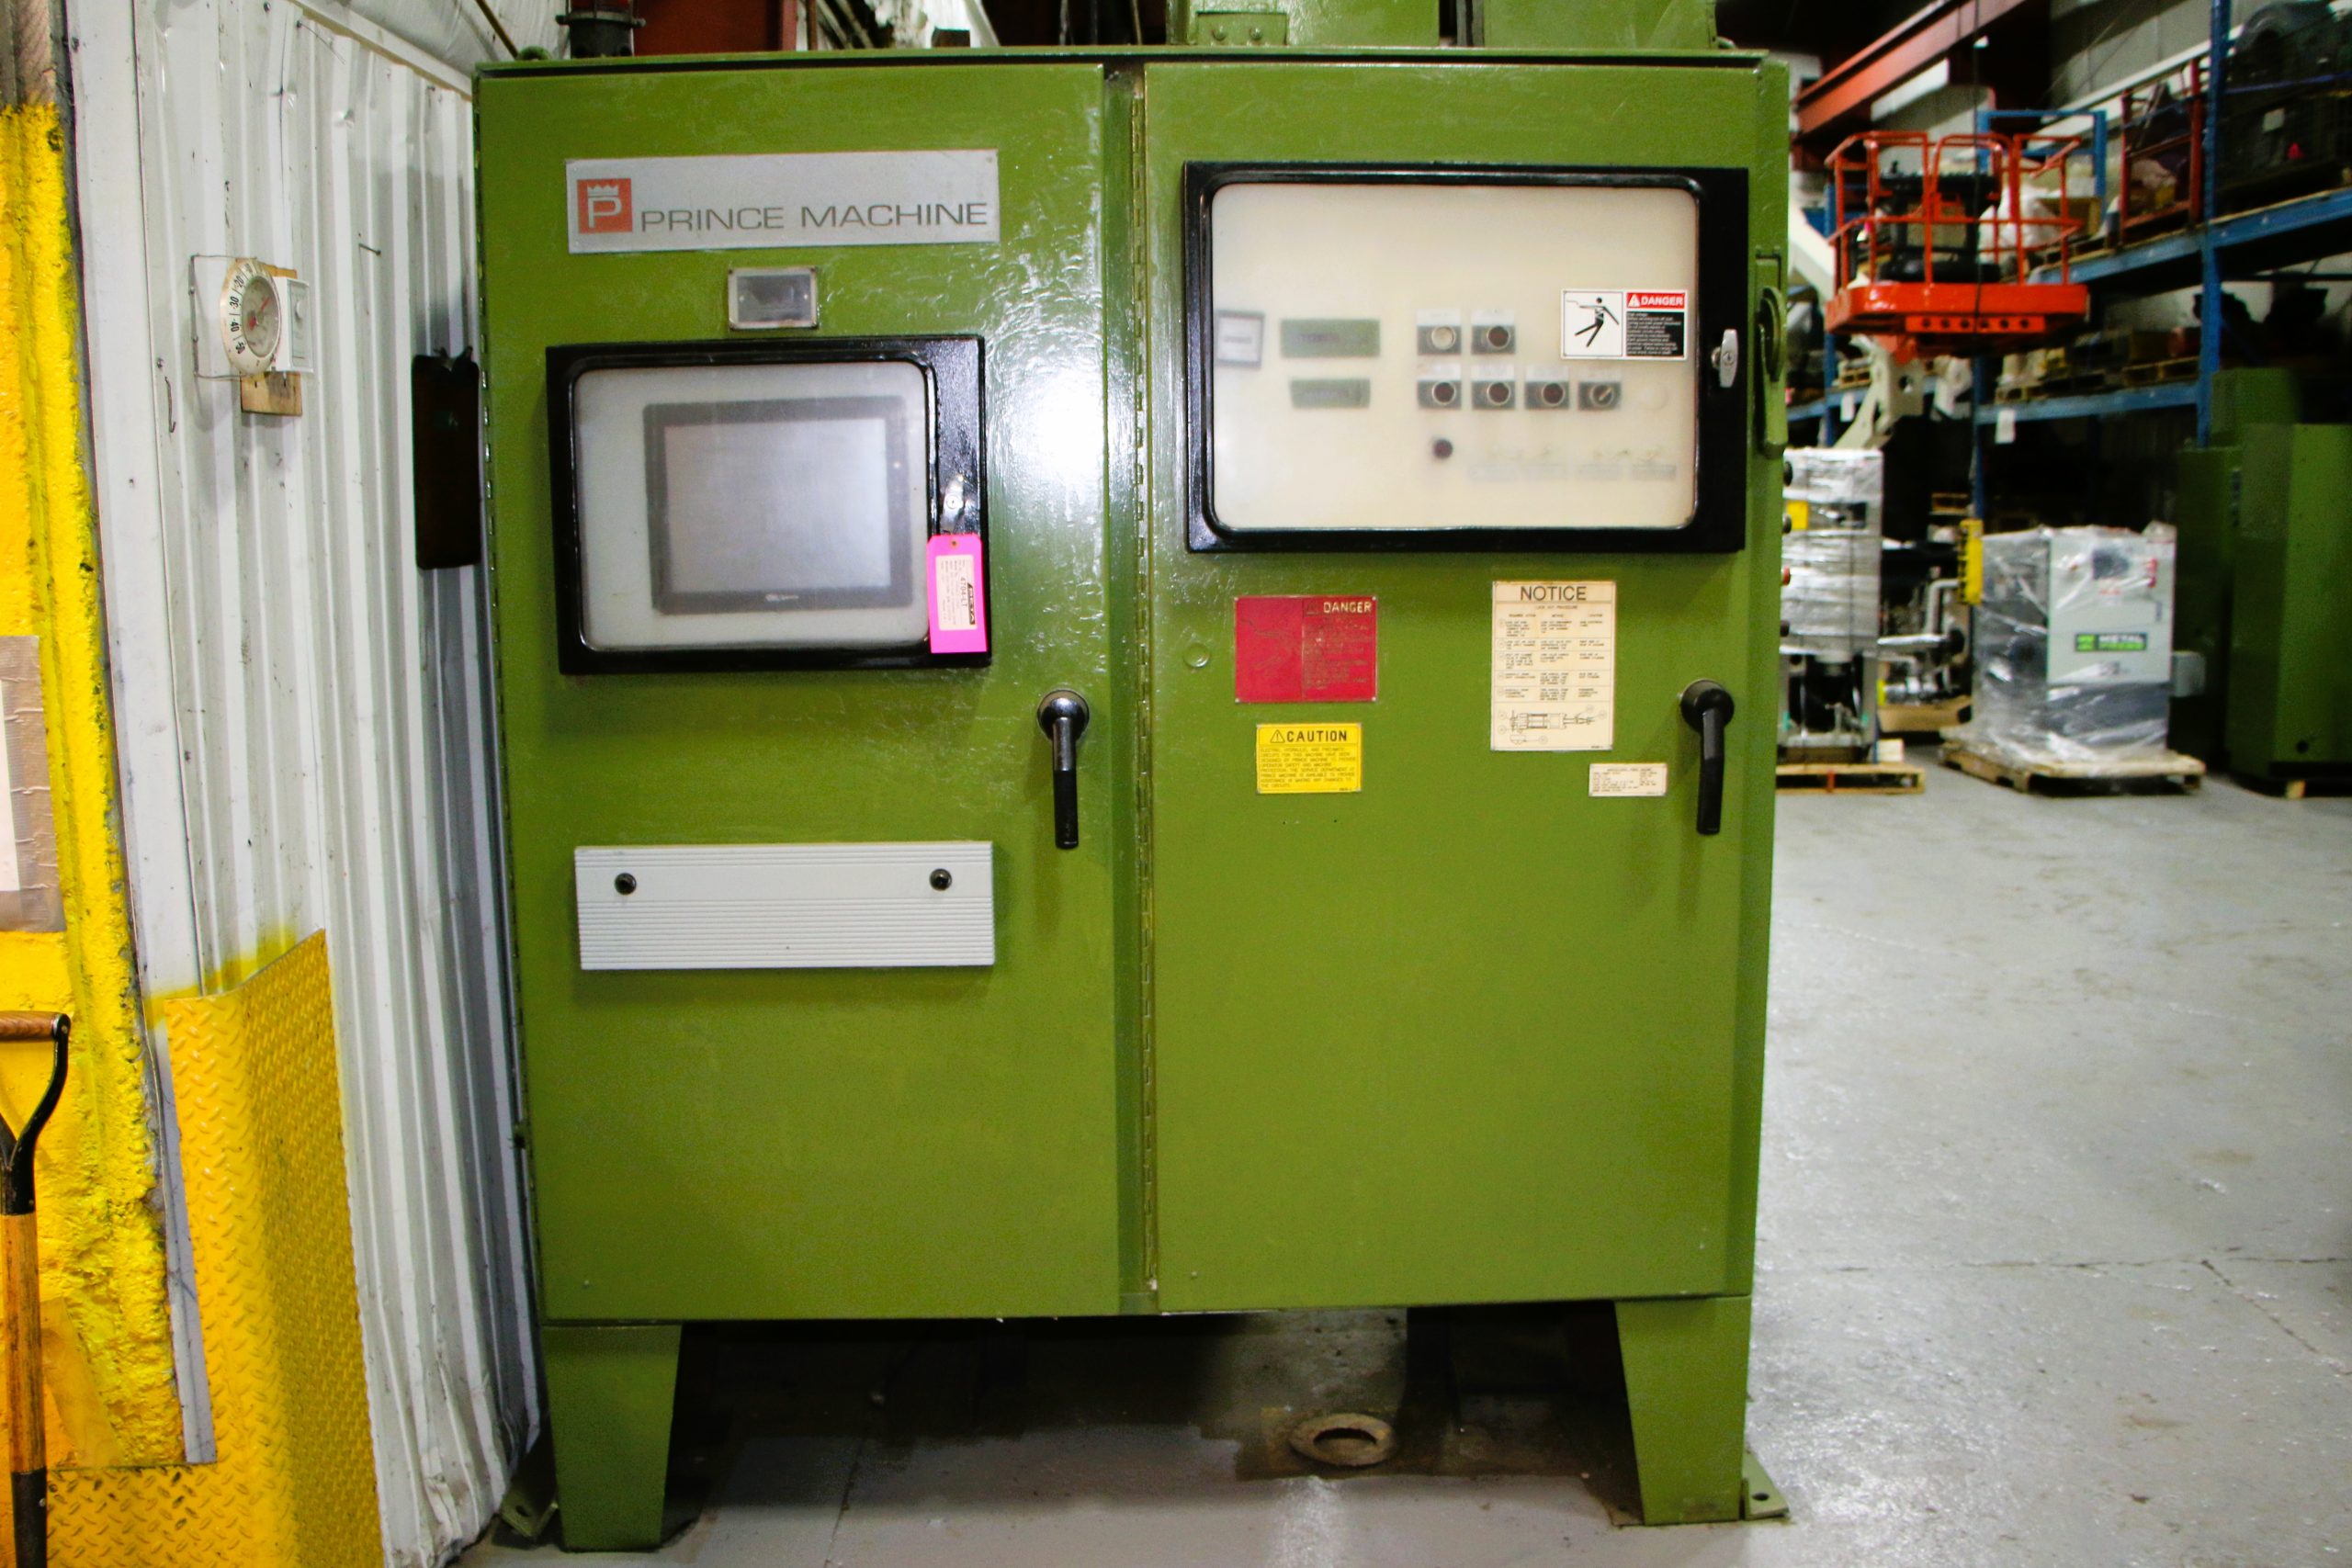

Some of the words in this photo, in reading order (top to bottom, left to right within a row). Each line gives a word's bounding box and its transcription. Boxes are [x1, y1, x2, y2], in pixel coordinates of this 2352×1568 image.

[642, 207, 785, 232] PRINCE
[801, 202, 988, 229] MACHINE
[1641, 295, 1684, 306] DANGER
[1521, 585, 1588, 602] NOTICE
[1323, 601, 1372, 614] DANGER
[1286, 730, 1348, 742] CAUTION
